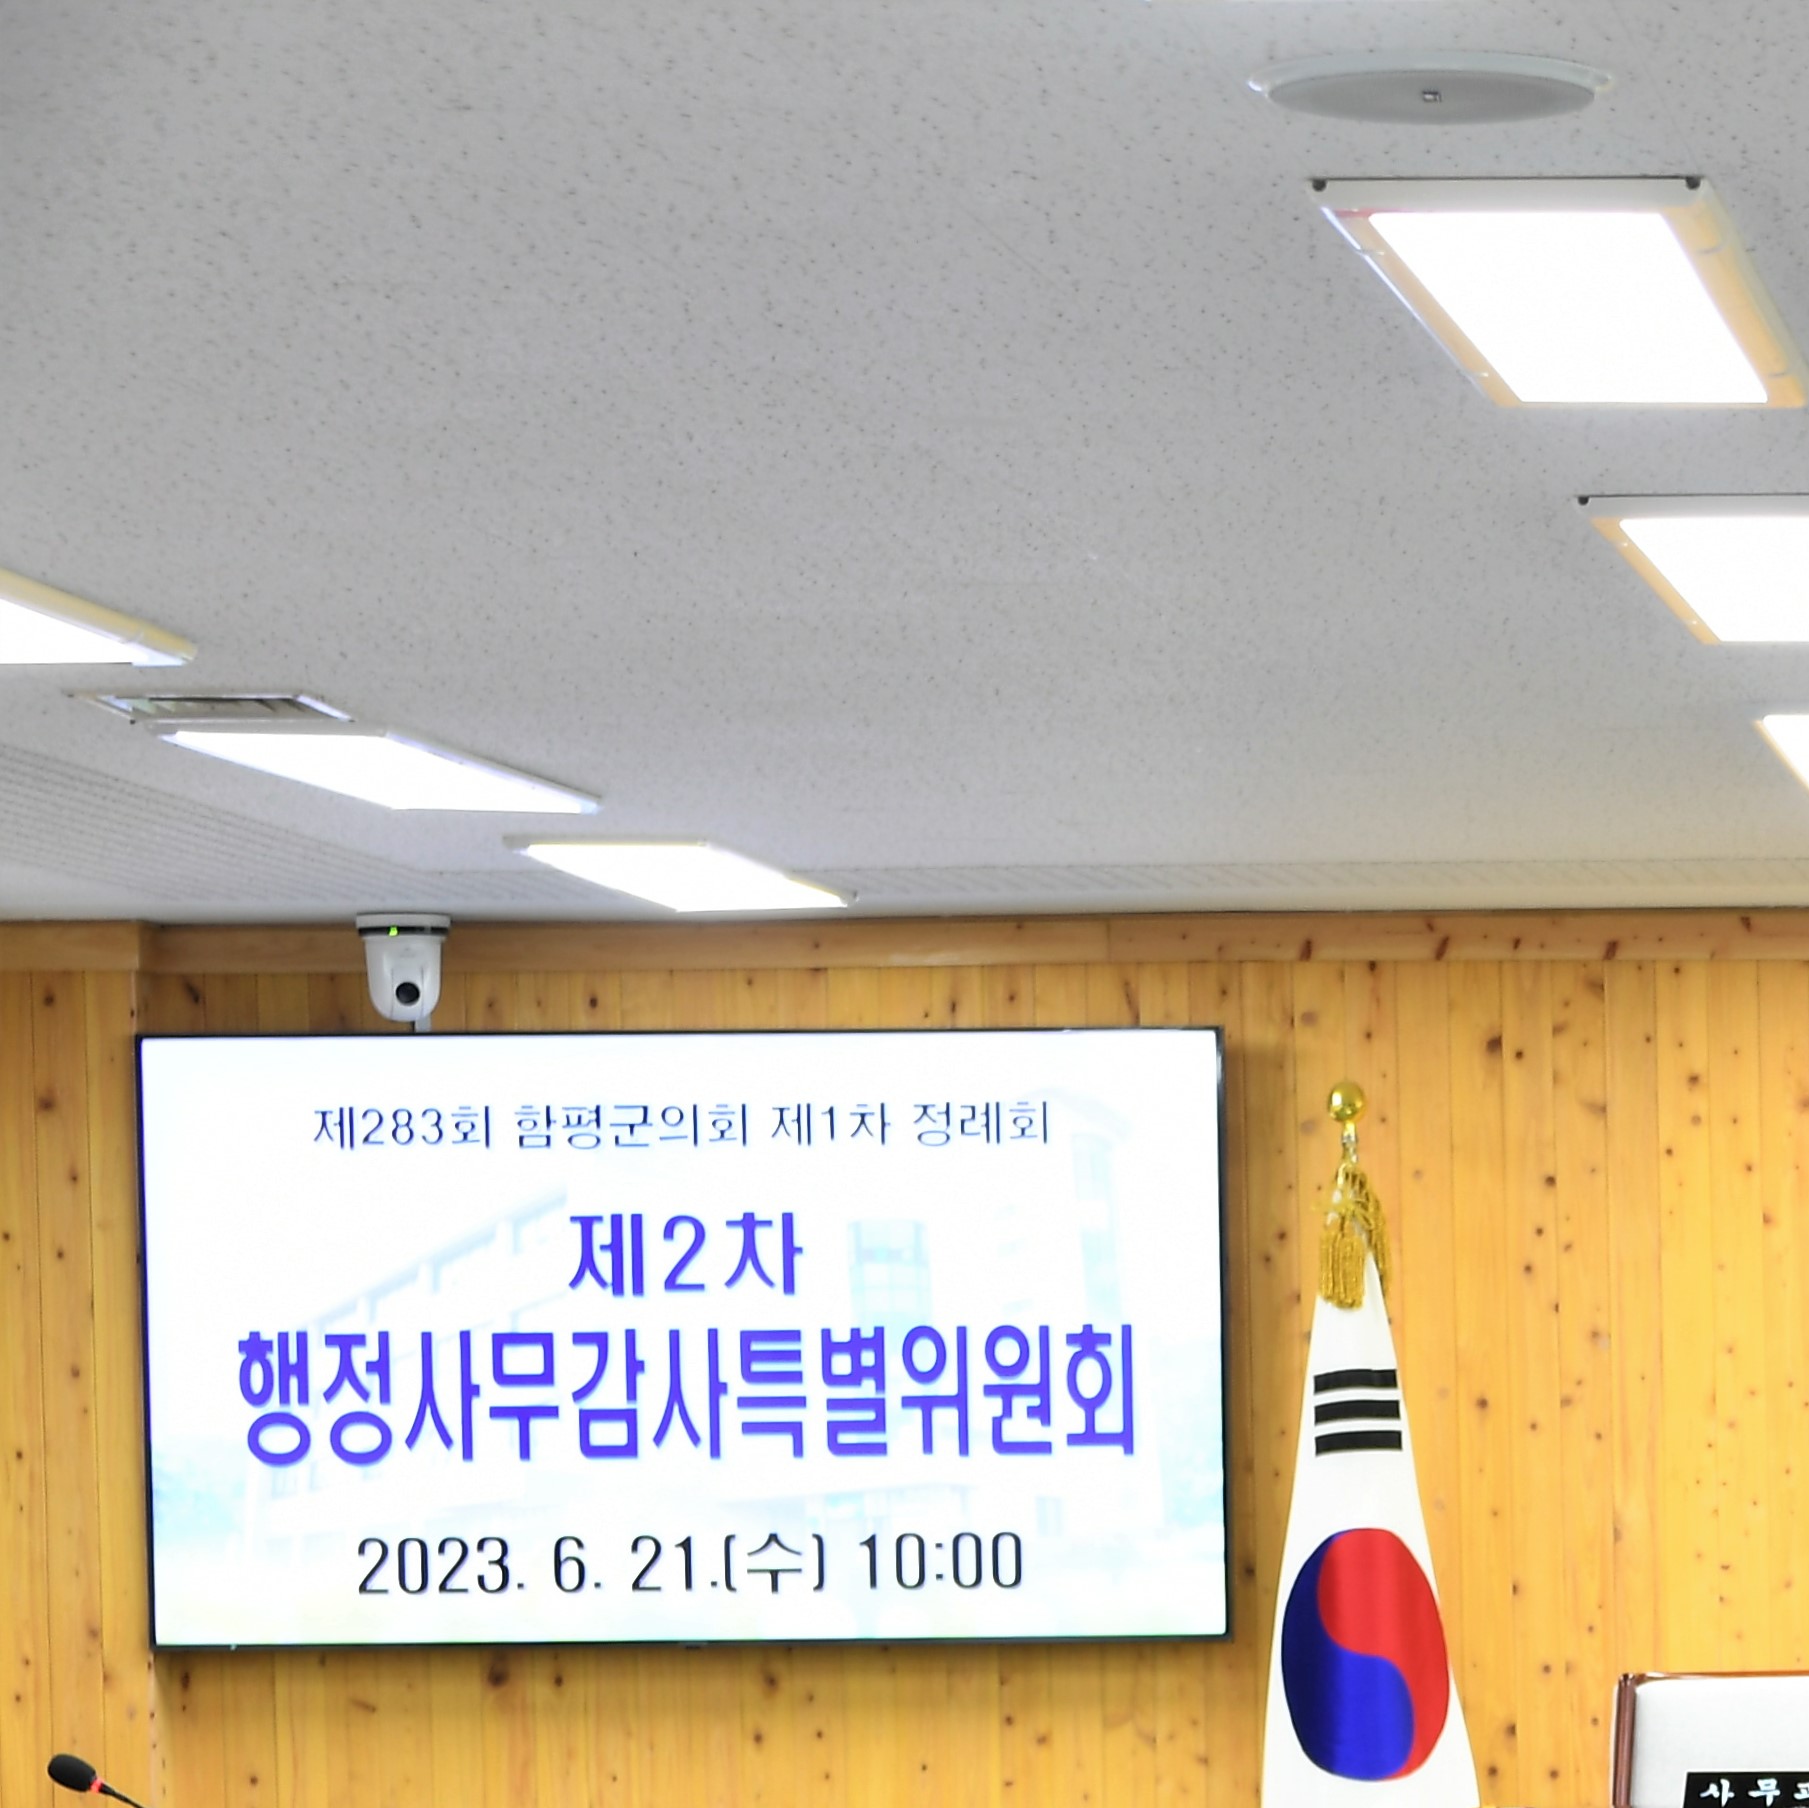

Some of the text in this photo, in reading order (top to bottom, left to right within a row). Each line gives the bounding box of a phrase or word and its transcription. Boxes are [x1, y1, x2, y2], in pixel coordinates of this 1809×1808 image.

[313, 1101, 1049, 1149] 제283회 함평군의회 제1차 정례회
[567, 1212, 804, 1297] 제2차
[238, 1323, 1135, 1468] 행정사무감사특별위원회
[357, 1531, 1022, 1595] 2023. 6. 21.(수) 10:00
